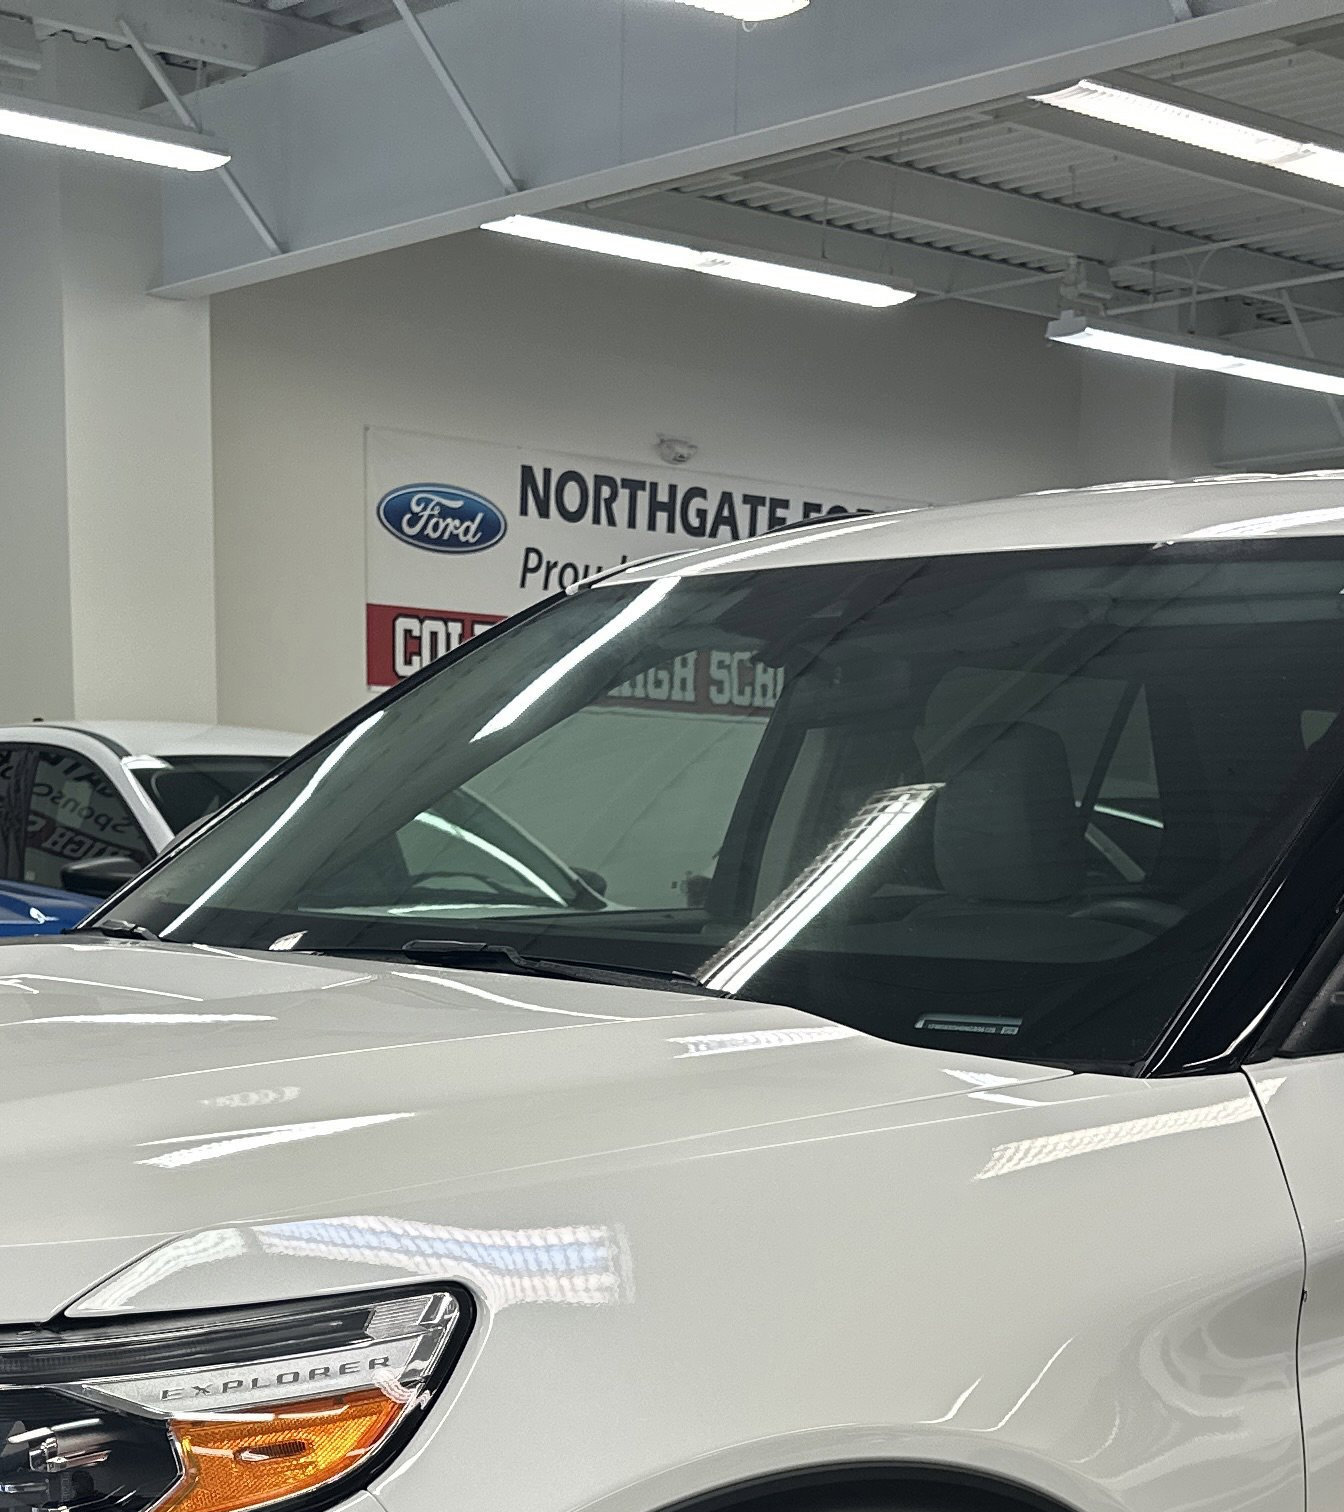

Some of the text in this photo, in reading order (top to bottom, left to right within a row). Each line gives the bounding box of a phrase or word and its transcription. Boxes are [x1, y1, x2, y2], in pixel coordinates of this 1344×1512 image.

[401, 493, 485, 543] Ford
[519, 464, 790, 541] NORTHGATE
[160, 1356, 391, 1400] EXPLORER
